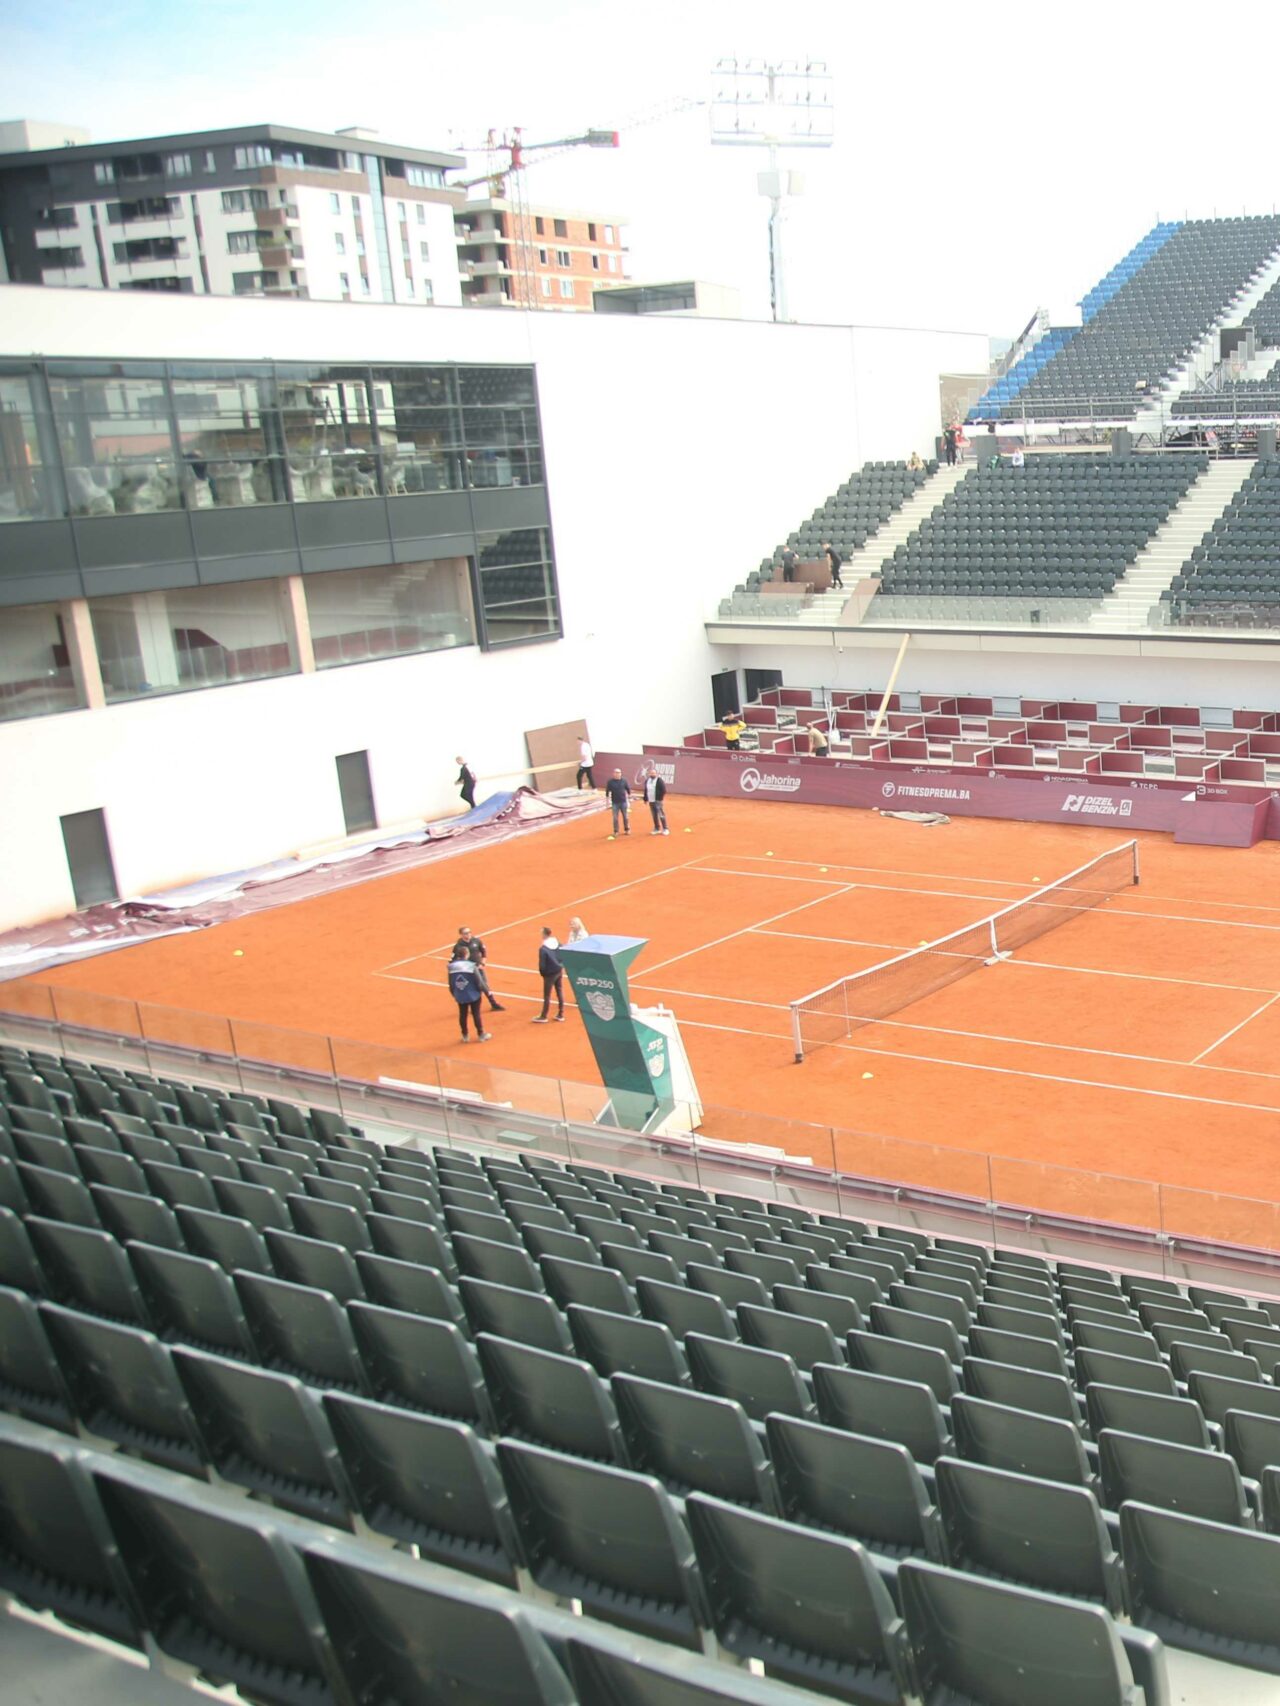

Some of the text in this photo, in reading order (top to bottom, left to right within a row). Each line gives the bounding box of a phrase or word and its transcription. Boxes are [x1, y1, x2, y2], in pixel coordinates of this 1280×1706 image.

[761, 773, 801, 787] Jahorina
[1139, 782, 1158, 790] TCPC
[897, 785, 970, 800] FITNESOPREMA.BA
[1085, 796, 1113, 806] DIZEL
[1081, 804, 1118, 815] BENZIN
